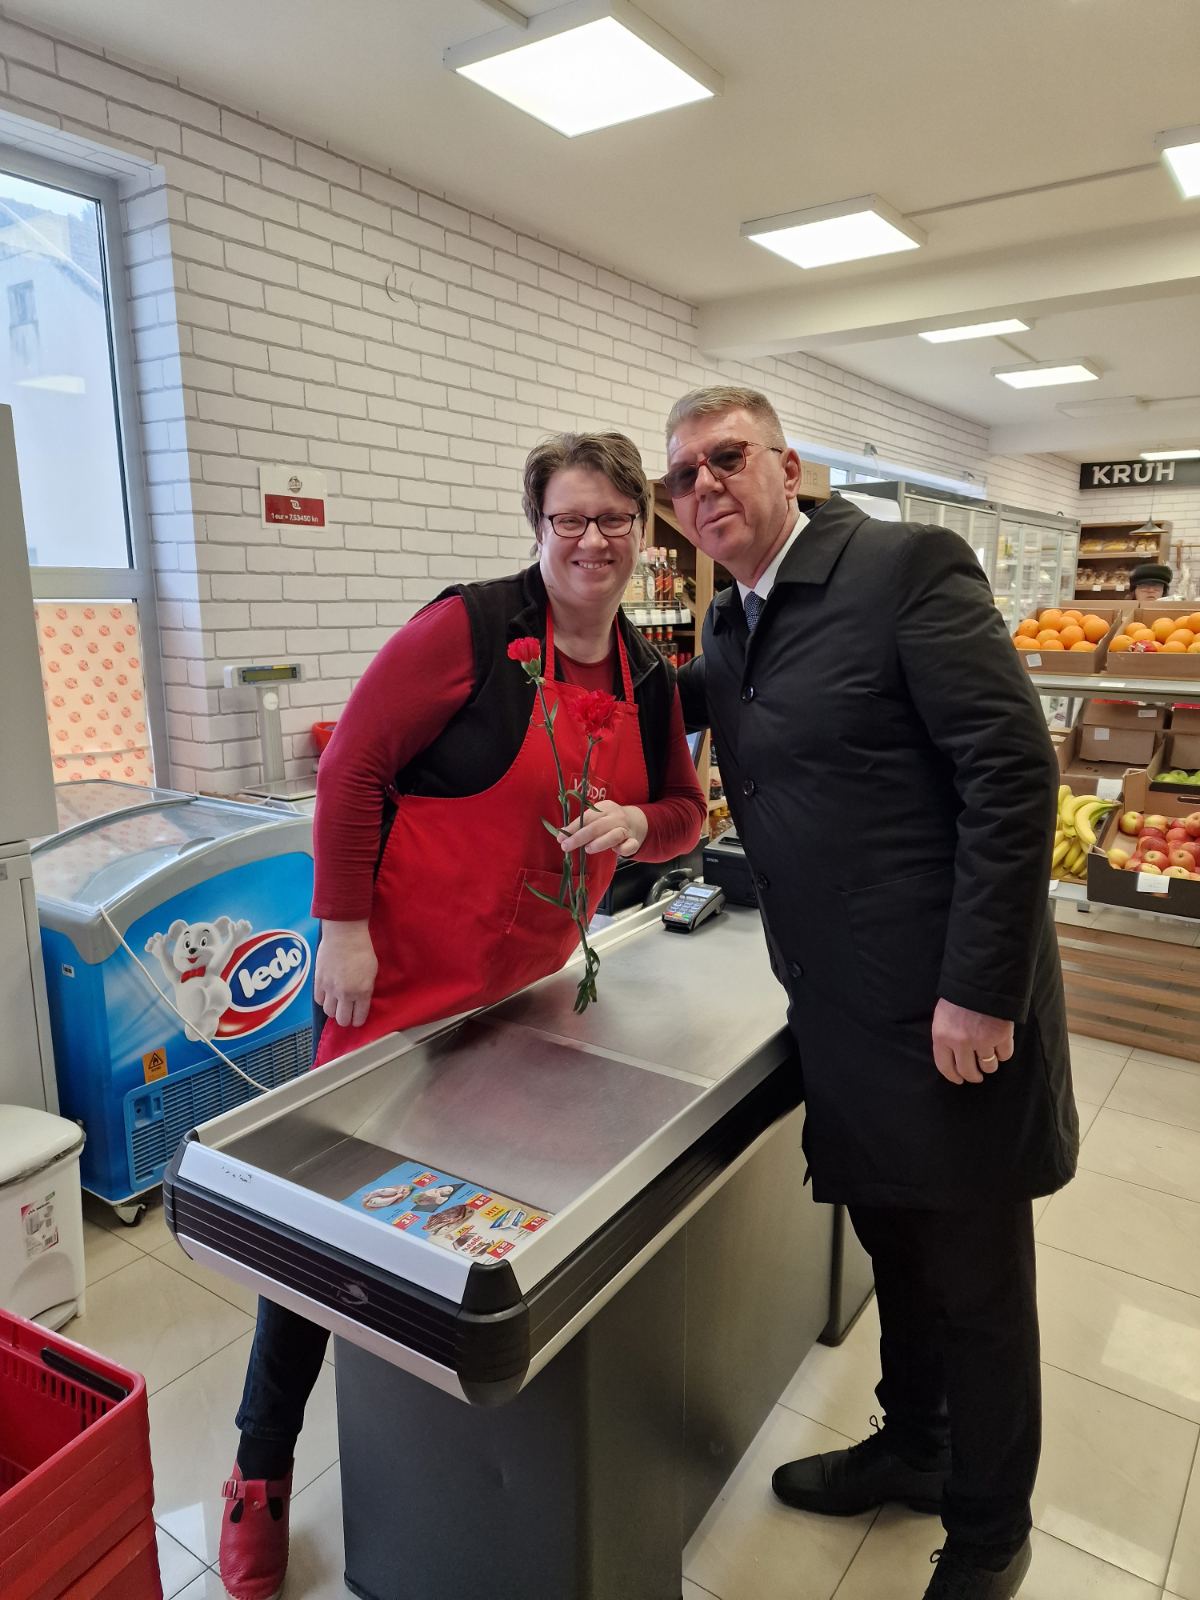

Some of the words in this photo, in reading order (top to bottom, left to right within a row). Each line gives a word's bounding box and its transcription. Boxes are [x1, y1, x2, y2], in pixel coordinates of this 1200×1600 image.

[1092, 461, 1175, 485] KRUH
[312, 515, 319, 523] kn
[238, 947, 302, 999] ledo
[485, 1205, 500, 1217] HIT
